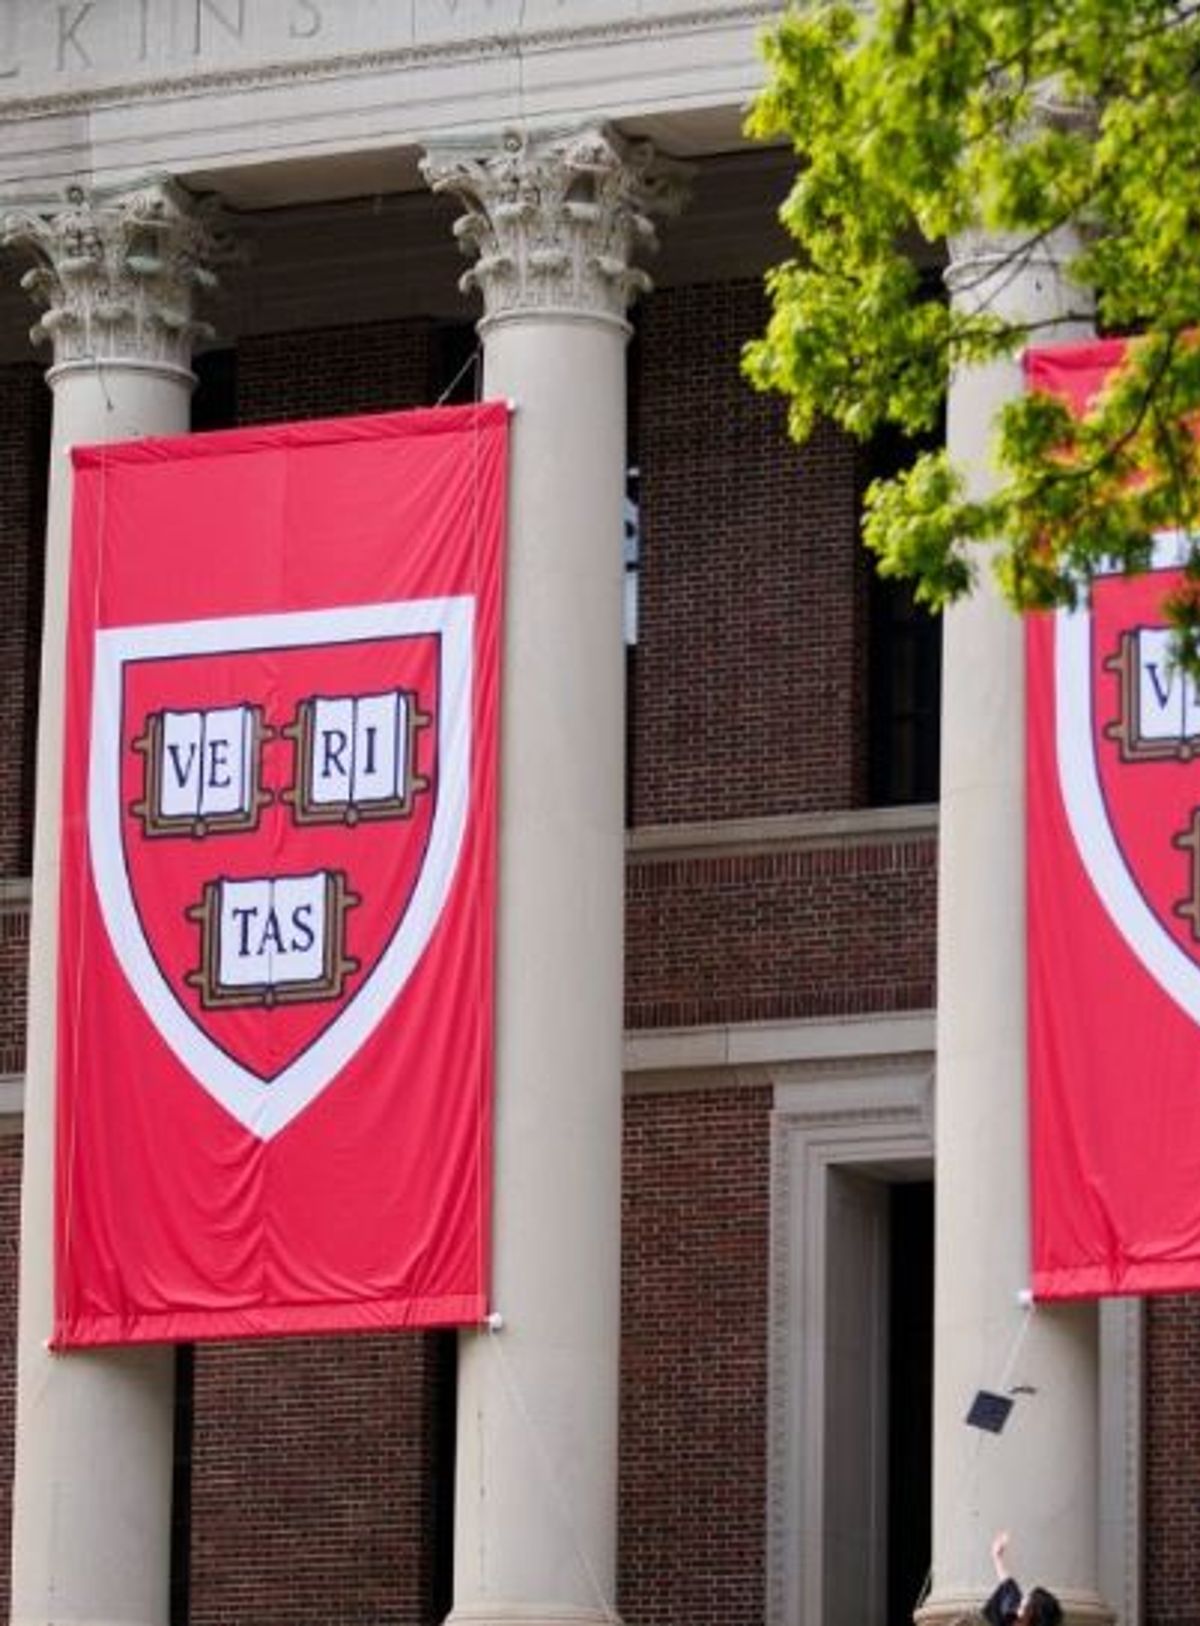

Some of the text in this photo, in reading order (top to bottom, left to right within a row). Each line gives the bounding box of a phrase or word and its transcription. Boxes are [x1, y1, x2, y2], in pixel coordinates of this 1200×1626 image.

[0, 0, 322, 78] KINS
[166, 726, 377, 789] VE RI
[231, 903, 315, 958] TAS
